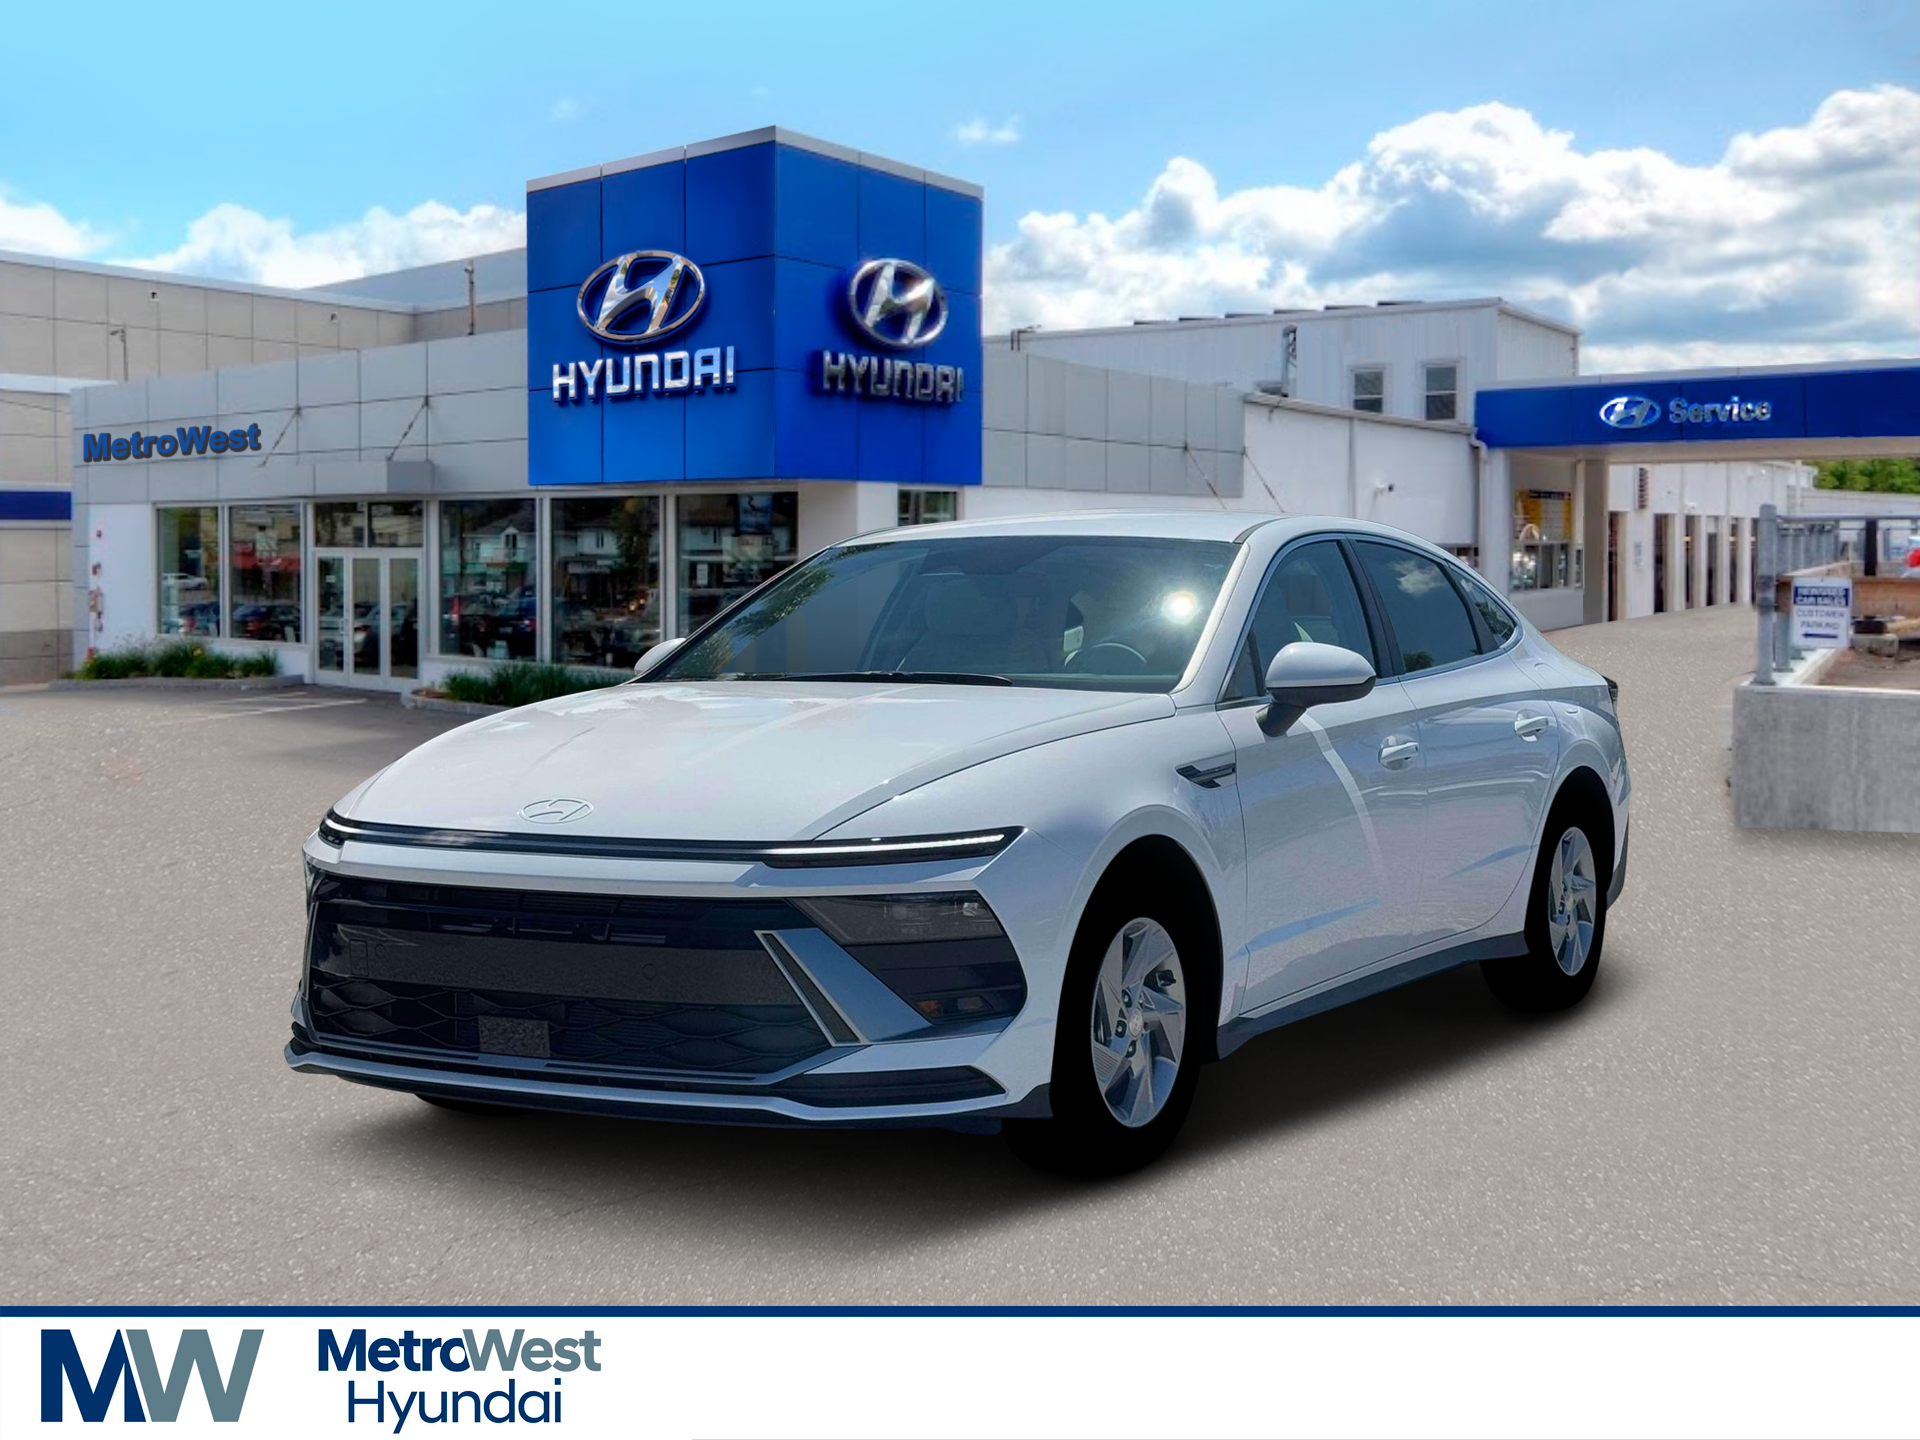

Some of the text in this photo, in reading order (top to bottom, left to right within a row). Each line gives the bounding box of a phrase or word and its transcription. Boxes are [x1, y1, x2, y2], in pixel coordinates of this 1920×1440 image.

[552, 346, 735, 399] HYUNDAI
[823, 350, 964, 403] HYUNDAI
[1669, 396, 1772, 424] Service
[83, 423, 262, 462] MetroWest
